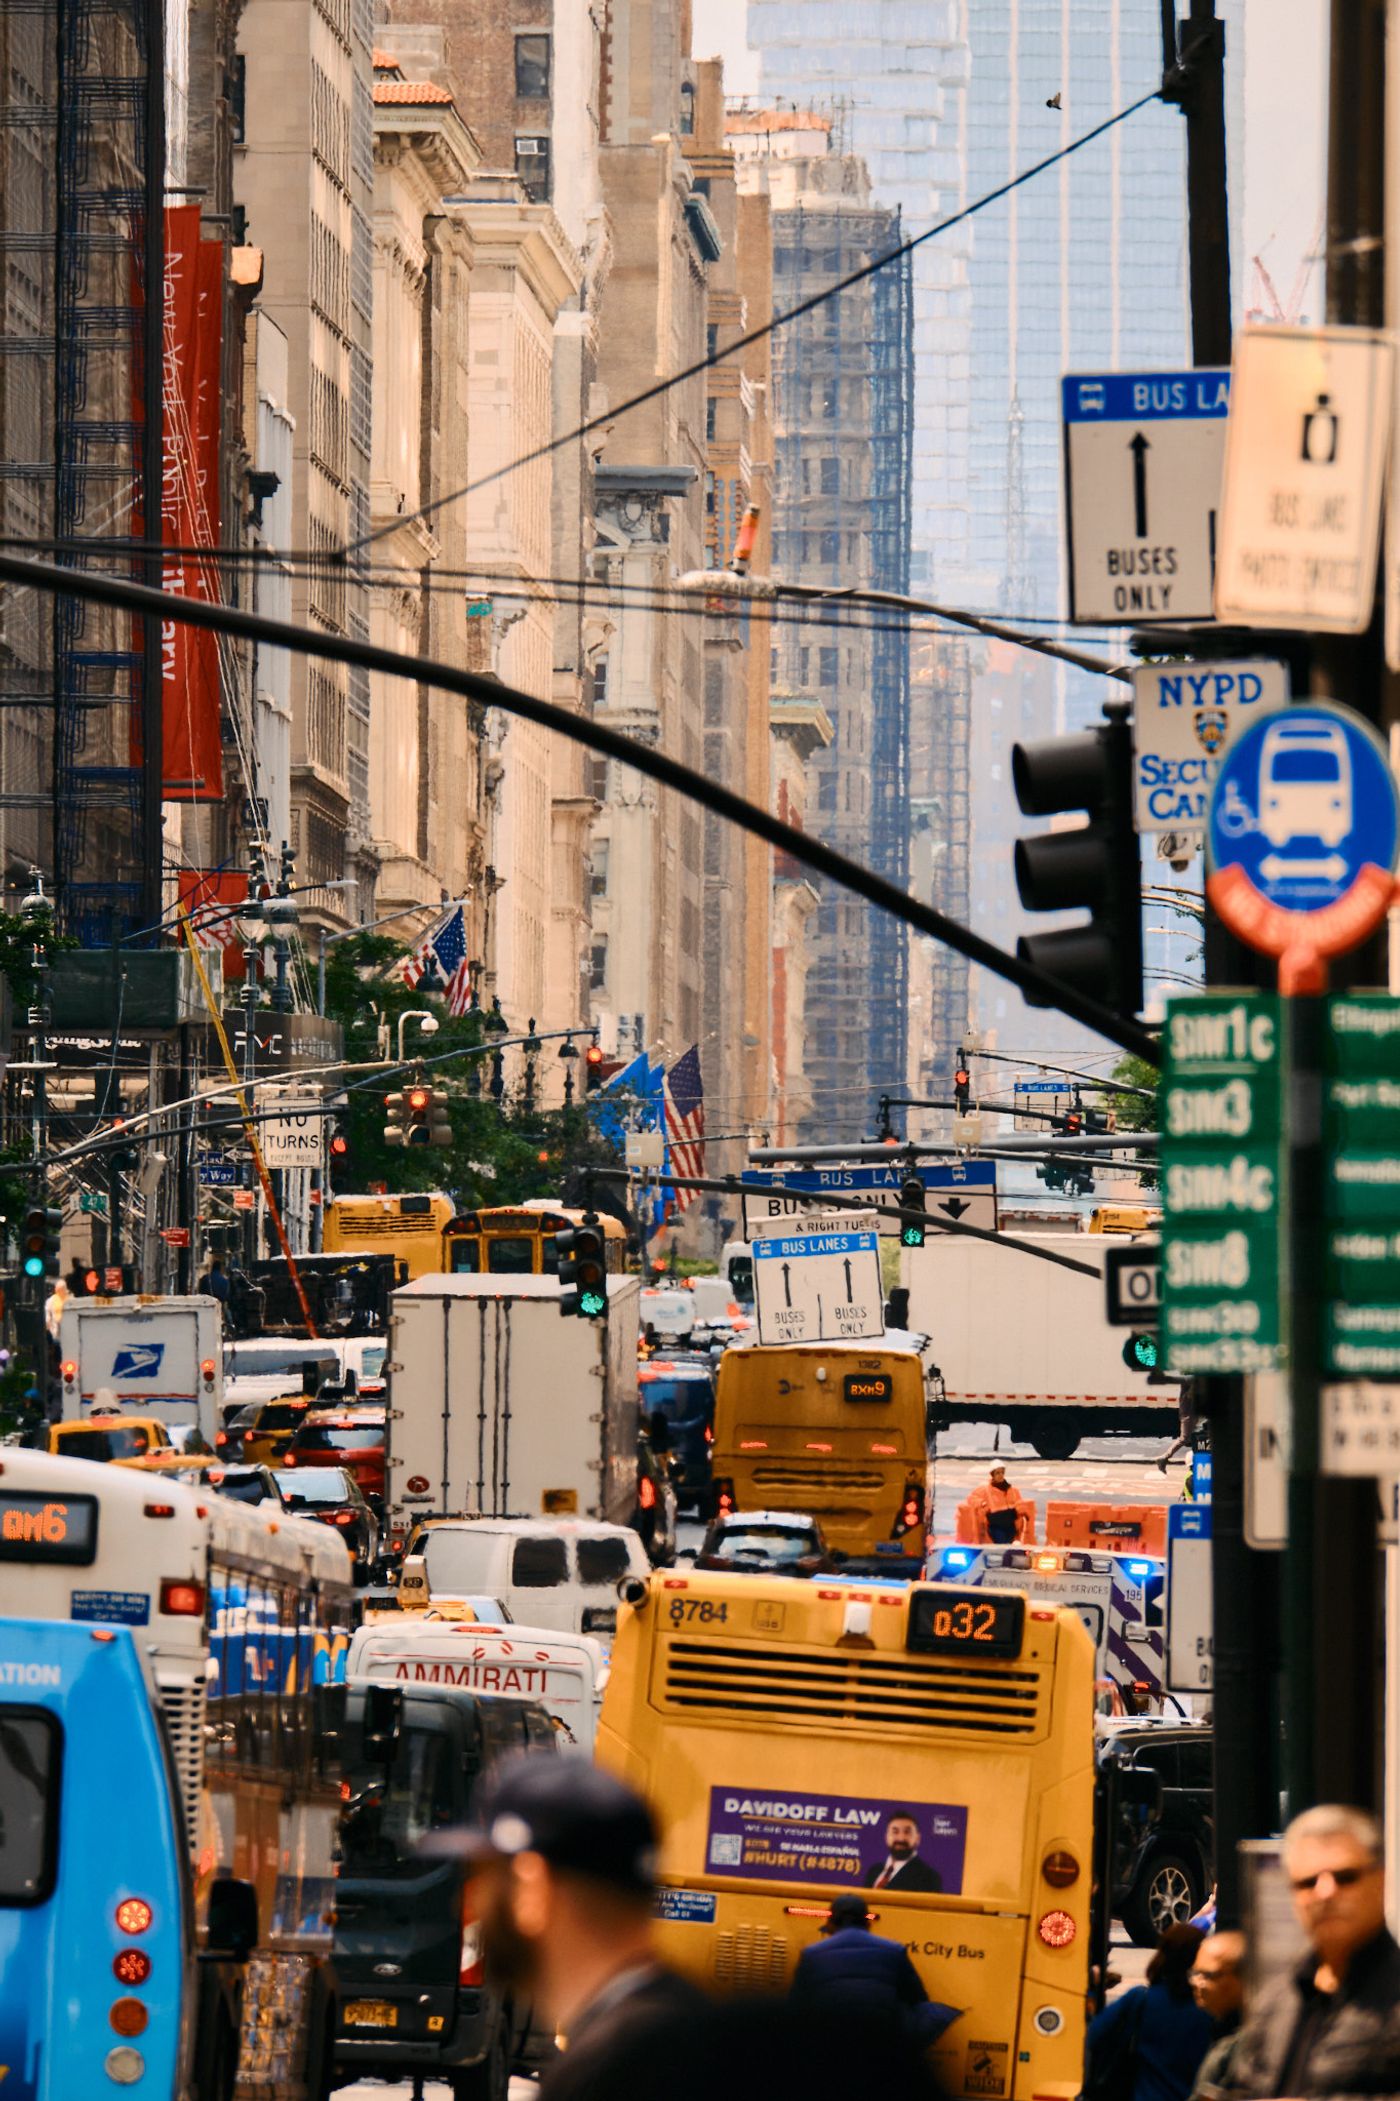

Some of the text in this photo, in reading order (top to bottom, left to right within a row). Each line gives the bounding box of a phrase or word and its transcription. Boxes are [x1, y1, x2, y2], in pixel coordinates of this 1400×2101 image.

[1132, 382, 1185, 411] BUS
[1107, 547, 1177, 576] BUSES
[1114, 584, 1172, 612] ONLY
[1158, 673, 1263, 707] NYPD
[267, 1134, 319, 1149] TURNS
[209, 1170, 232, 1180] Way
[808, 1222, 839, 1232] RIGHT
[782, 1237, 849, 1254] BUS LANES
[775, 1307, 867, 1324] BUSES BUSES
[779, 1322, 865, 1340] ONLY ONLY
[851, 1381, 885, 1396] BXM9
[3, 1503, 68, 1542] QM6
[670, 1598, 727, 1623] 8784
[933, 1602, 996, 1640] Q32
[396, 1661, 547, 1693] AMMIRATI
[724, 1798, 881, 1826] DAVIDOFF LAW
[744, 1851, 798, 1867] #HURT
[923, 1941, 953, 1959] City
[958, 1945, 984, 1958] Bus
